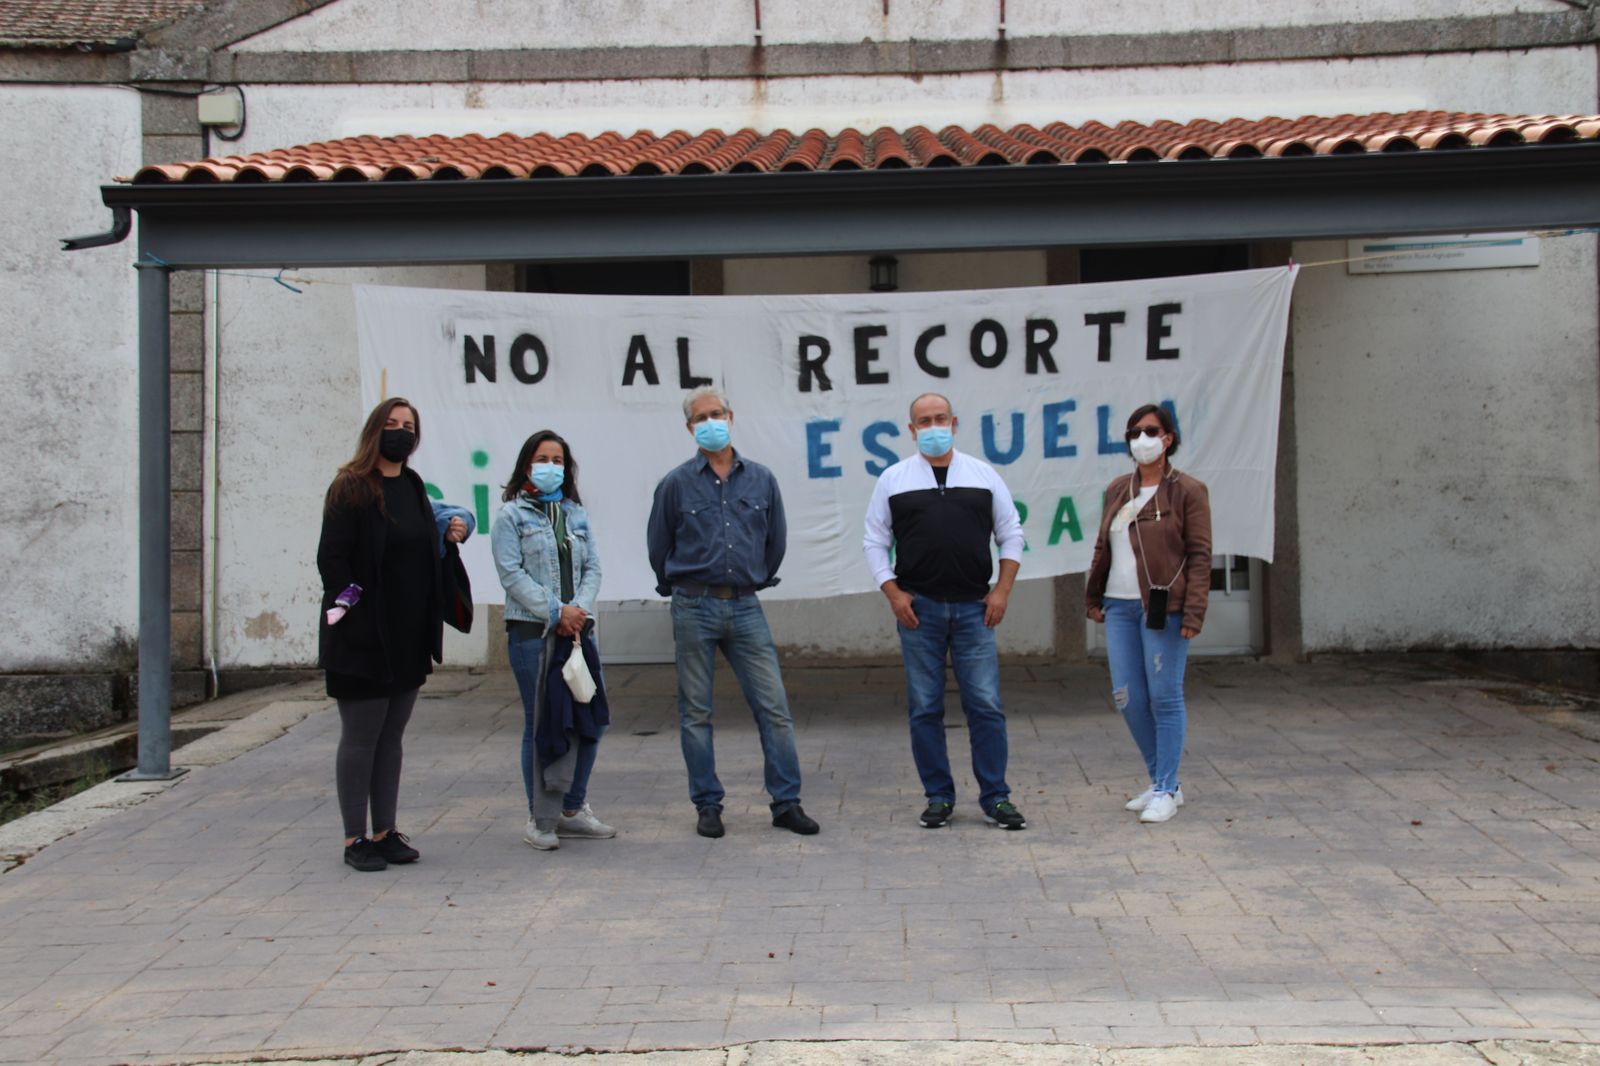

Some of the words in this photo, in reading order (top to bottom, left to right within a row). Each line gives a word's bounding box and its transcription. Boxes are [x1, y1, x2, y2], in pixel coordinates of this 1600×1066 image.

[464, 333, 548, 384] NO
[622, 335, 712, 388] AL
[799, 303, 1182, 391] RECORTE
[806, 399, 1181, 478] ESUEL
